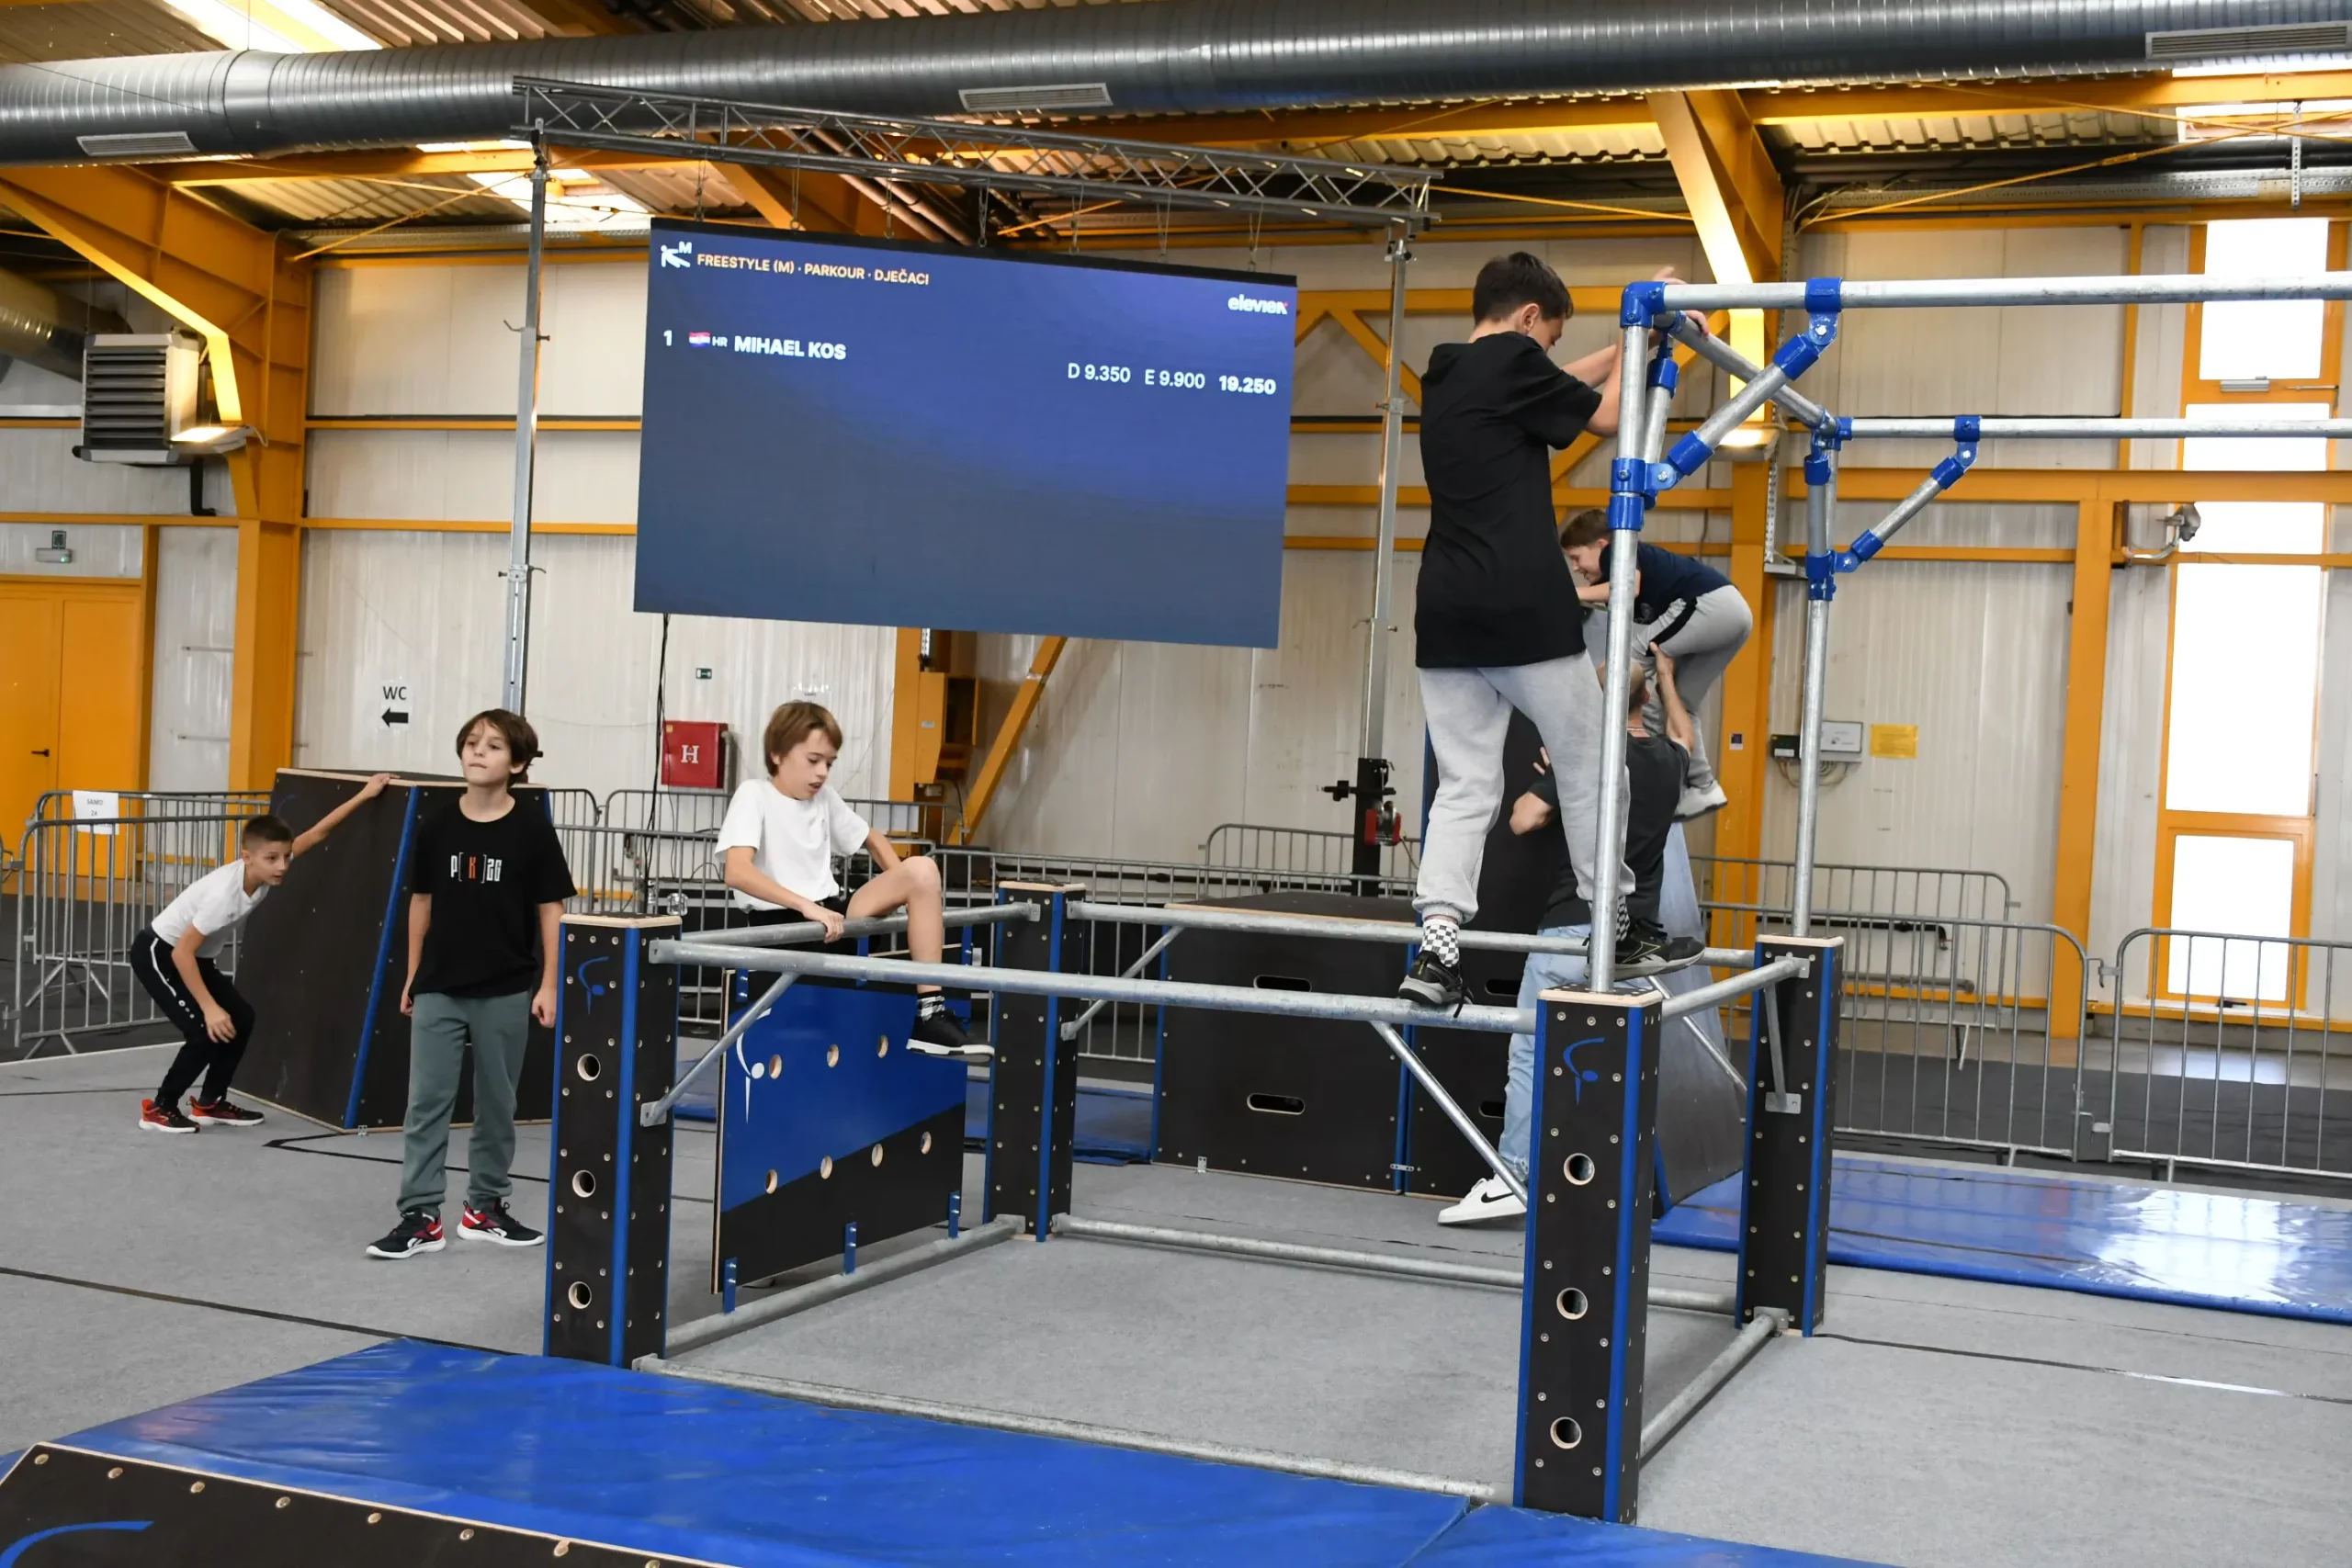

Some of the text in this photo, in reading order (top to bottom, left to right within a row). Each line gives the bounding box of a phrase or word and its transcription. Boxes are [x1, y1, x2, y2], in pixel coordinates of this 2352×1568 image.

[697, 253, 929, 286] FREESTYLE (M) PARKOUR DJEČACI
[663, 329, 1277, 395] 1 HR MIHAEL KOS D 9.350 E 9.900 19.250
[382, 685, 408, 701] WC
[681, 744, 699, 764] H
